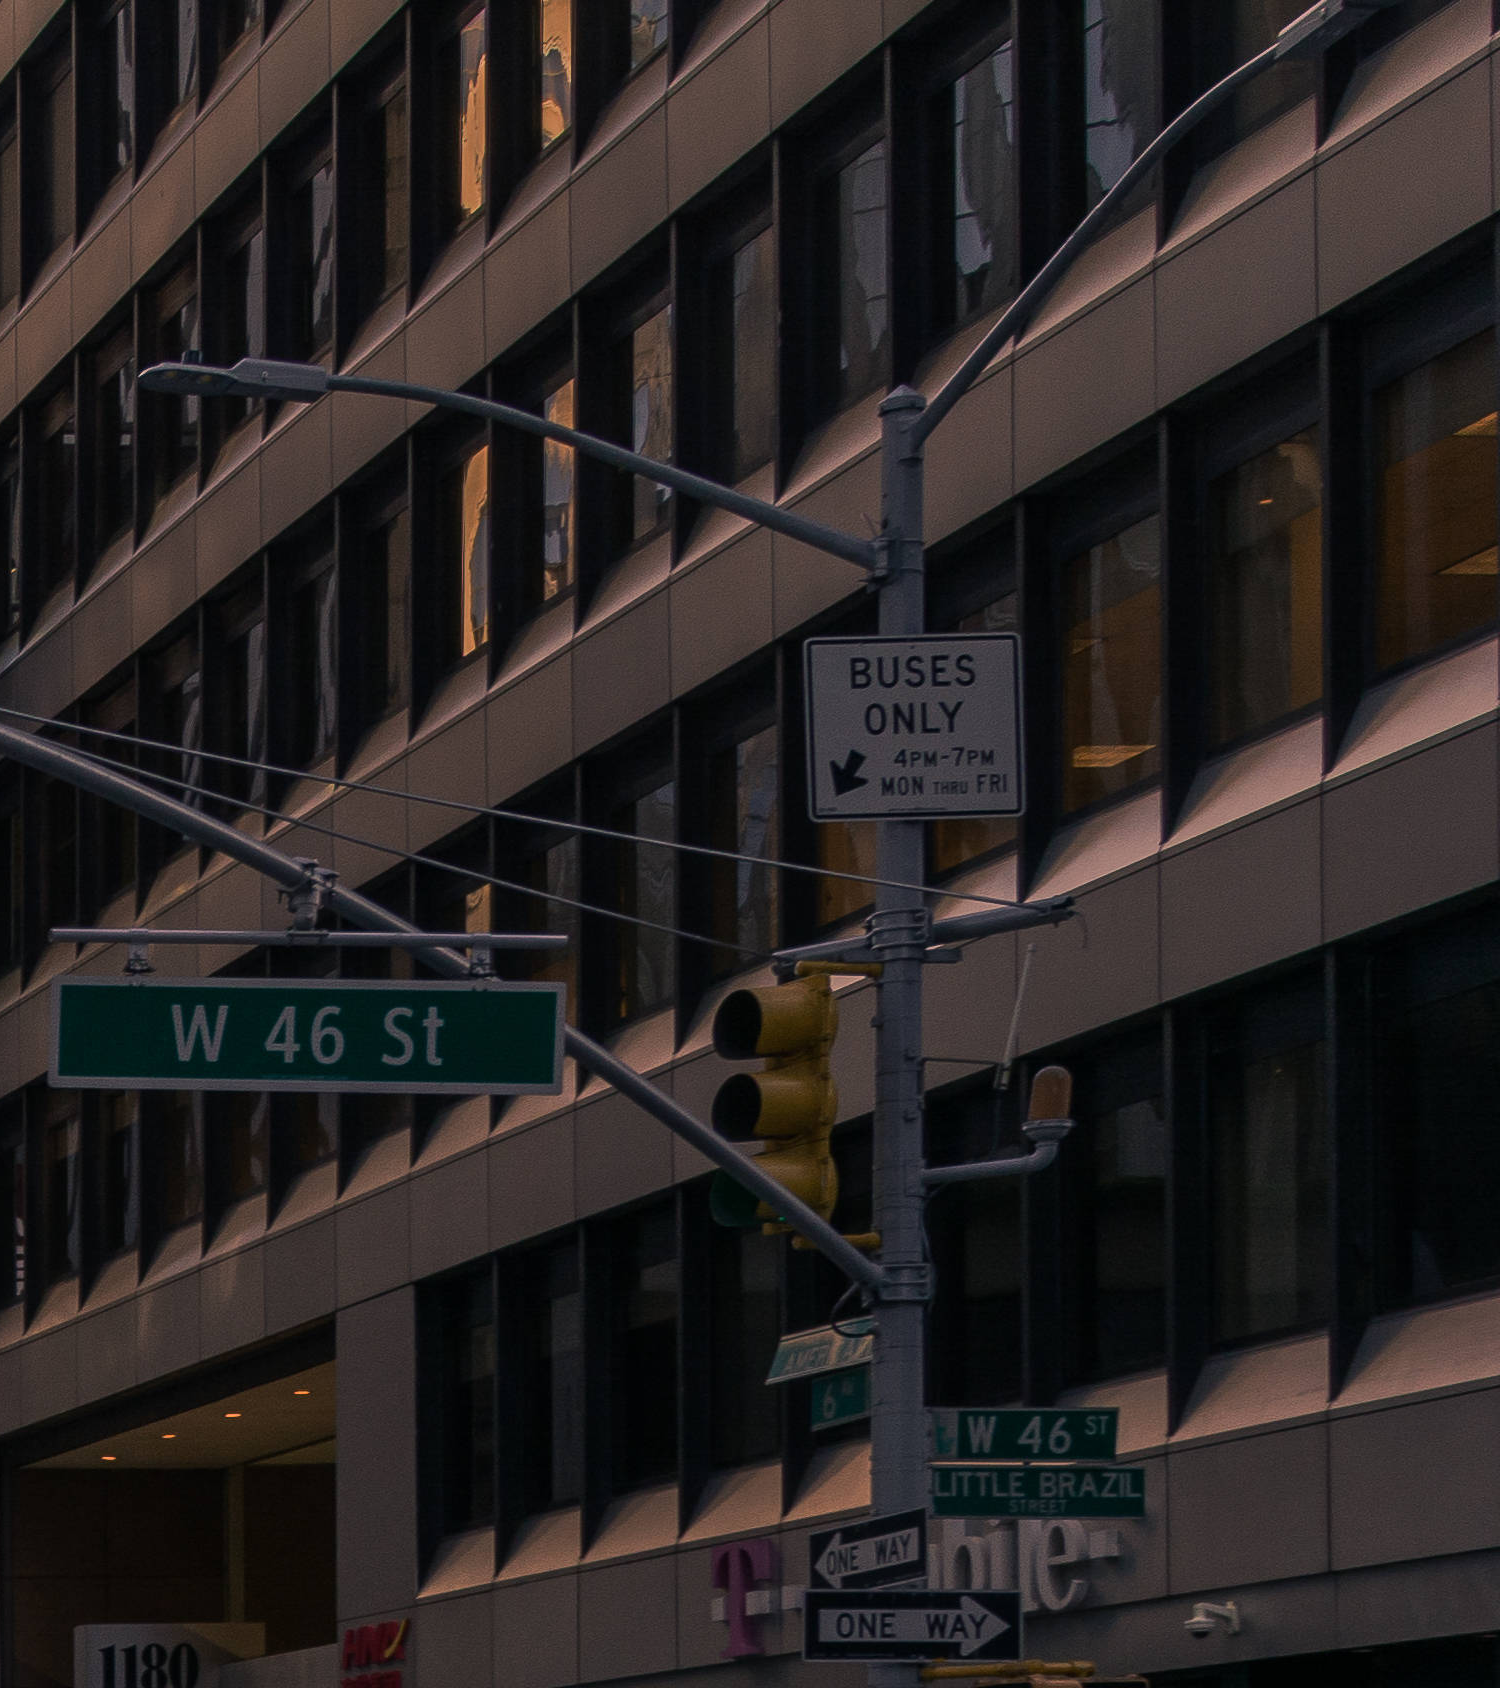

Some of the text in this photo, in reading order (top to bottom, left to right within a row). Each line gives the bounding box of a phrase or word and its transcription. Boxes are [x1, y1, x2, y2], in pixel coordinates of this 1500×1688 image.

[850, 654, 976, 689] BUSES
[865, 701, 964, 735] ONLY
[894, 747, 995, 768] 4PM-7PM
[881, 774, 1007, 796] MON THRU FRI
[171, 1004, 445, 1066] W 46 St
[967, 1415, 1108, 1454] W 46 ST
[934, 1471, 1142, 1500] LITTLE BRAZIL
[1008, 1500, 1067, 1513] STREET
[826, 1532, 912, 1576] ONE WAY
[836, 1612, 988, 1639] ONE WAY
